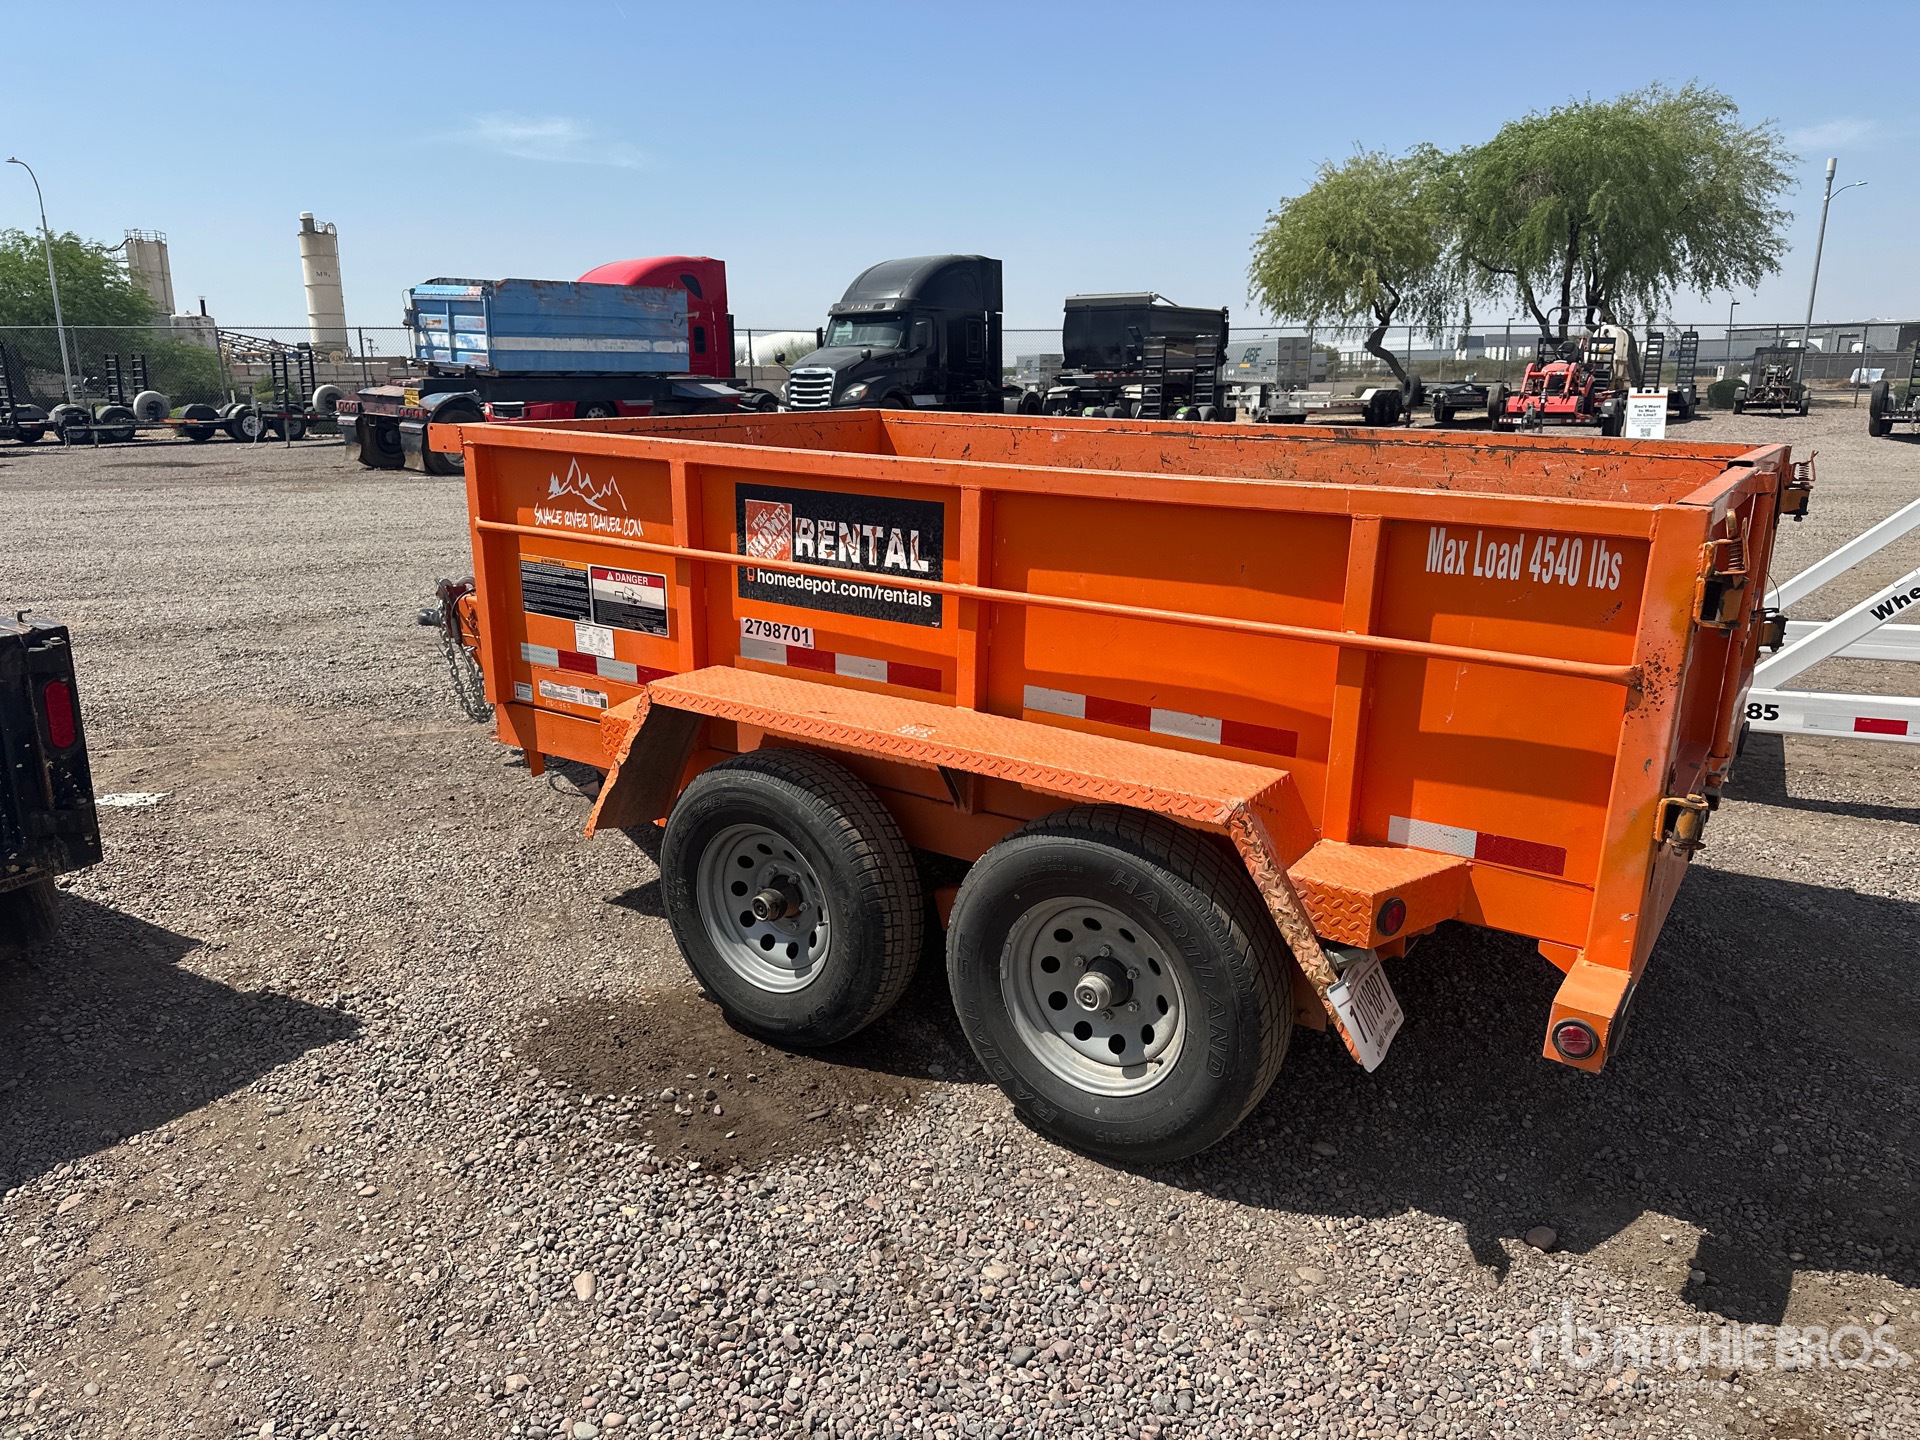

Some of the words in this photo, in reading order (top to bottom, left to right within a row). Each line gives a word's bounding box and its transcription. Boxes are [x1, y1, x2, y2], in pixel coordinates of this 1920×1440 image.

[1242, 347, 1262, 362] ABF
[534, 502, 562, 526] SNAKE
[564, 508, 588, 529] RIVER
[589, 512, 643, 537] TRAILER.COM
[747, 504, 791, 558] HOME
[751, 508, 769, 531] THE
[764, 526, 791, 560] DEPOT
[795, 517, 929, 573] RENTAL
[1425, 527, 1469, 575] Max
[1473, 530, 1525, 580] Load
[1529, 535, 1583, 587] 4540
[1587, 539, 1623, 590] lbs
[615, 572, 649, 586] DANGER
[757, 568, 932, 607] homedepot.com/rentals
[744, 618, 810, 644] 2798701
[1745, 702, 1780, 721] 85
[1108, 869, 1229, 1079] HARTLAND
[964, 1000, 1058, 1123] RADIAL
